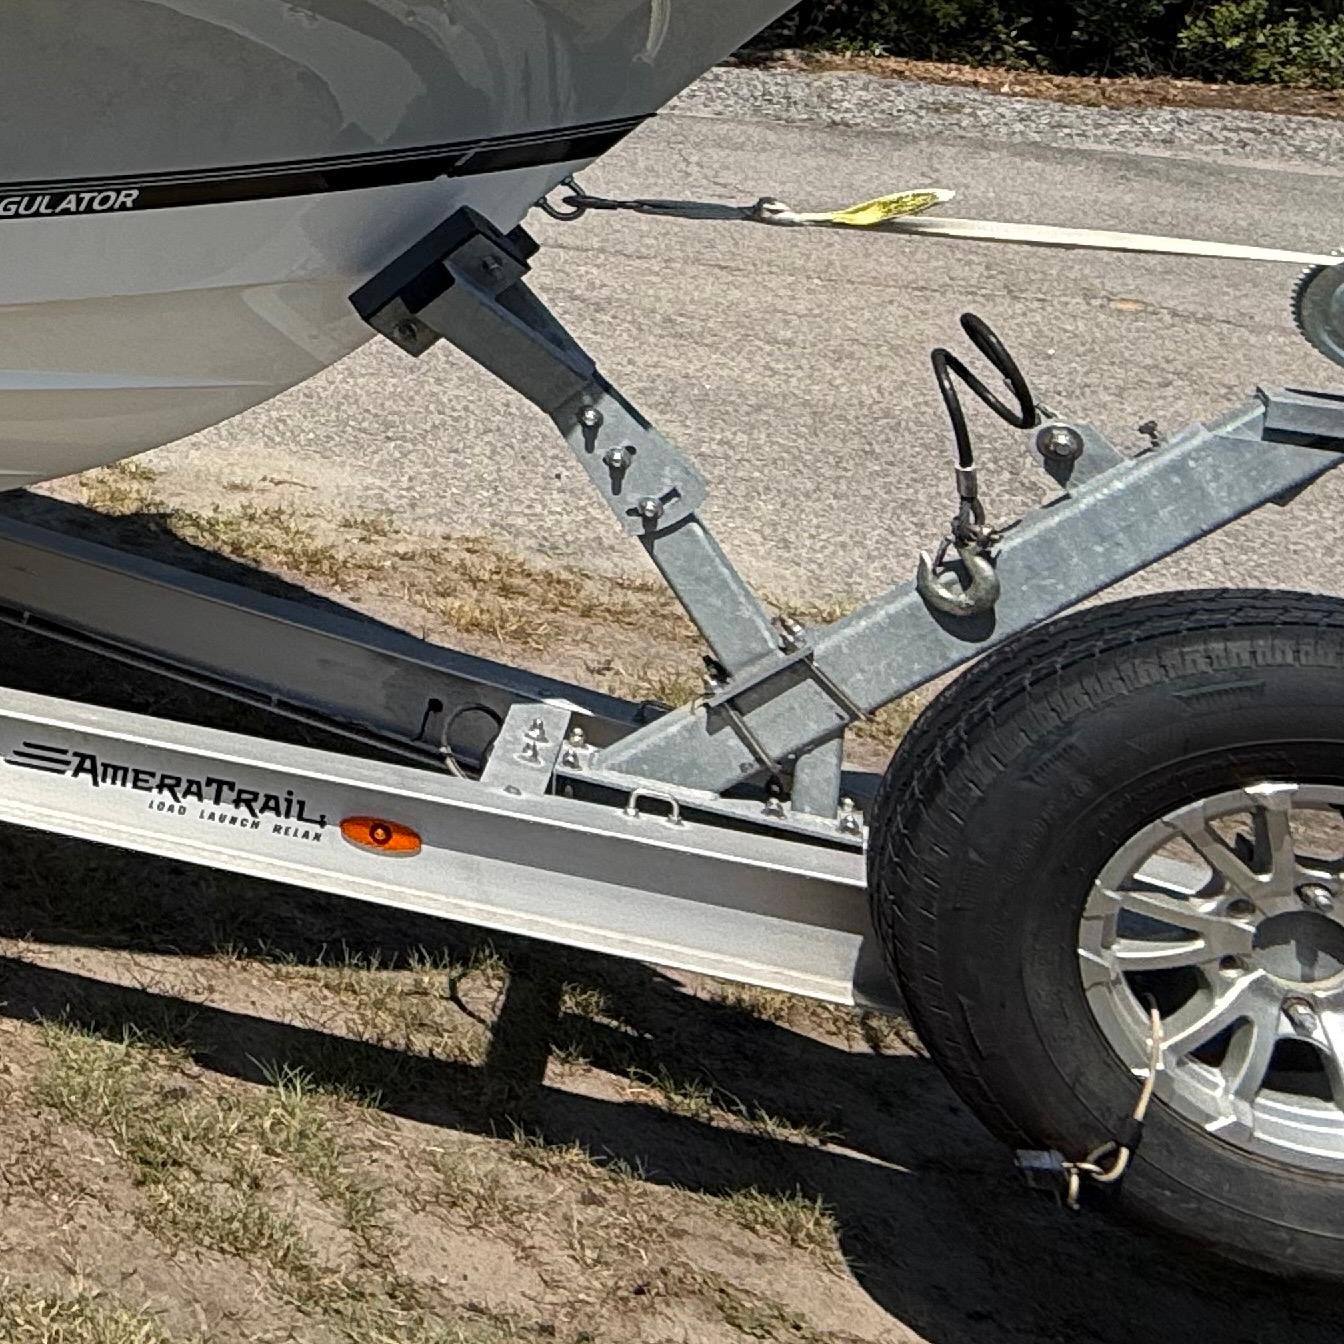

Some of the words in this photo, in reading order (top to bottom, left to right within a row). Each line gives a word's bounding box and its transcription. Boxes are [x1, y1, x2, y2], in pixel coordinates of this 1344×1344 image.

[148, 800, 187, 816] LOAD
[199, 808, 261, 830] LAUNCH
[272, 823, 323, 843] RELAX
